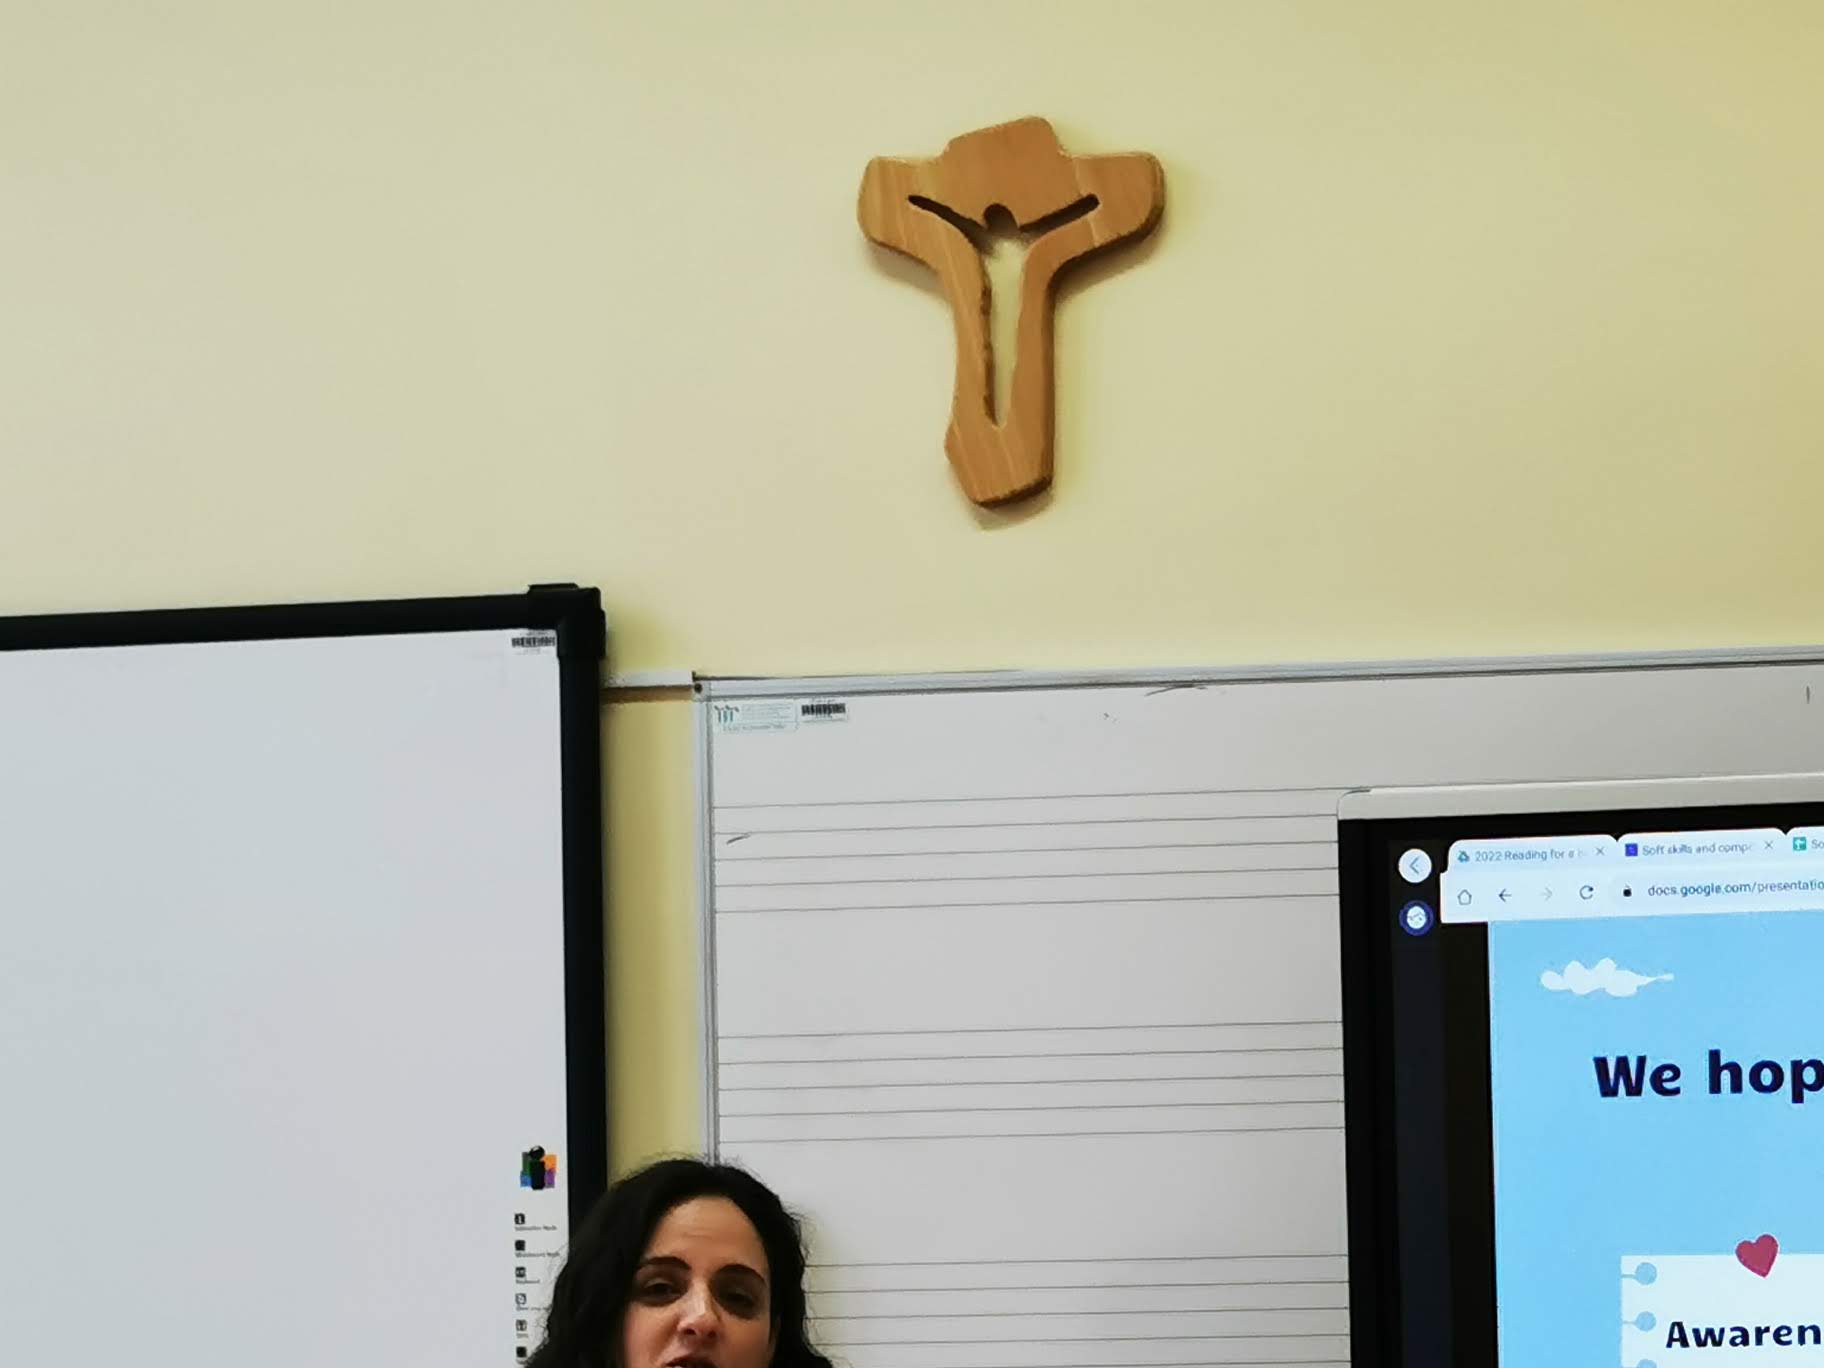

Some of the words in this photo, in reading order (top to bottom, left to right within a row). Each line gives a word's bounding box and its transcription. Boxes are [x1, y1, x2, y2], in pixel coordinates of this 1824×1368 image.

[1475, 850, 1501, 862] 2022
[1504, 849, 1547, 860] Reading
[1551, 849, 1565, 859] for
[1643, 845, 1664, 856] Soft
[1696, 843, 1715, 853] and
[1592, 1054, 1682, 1098] We
